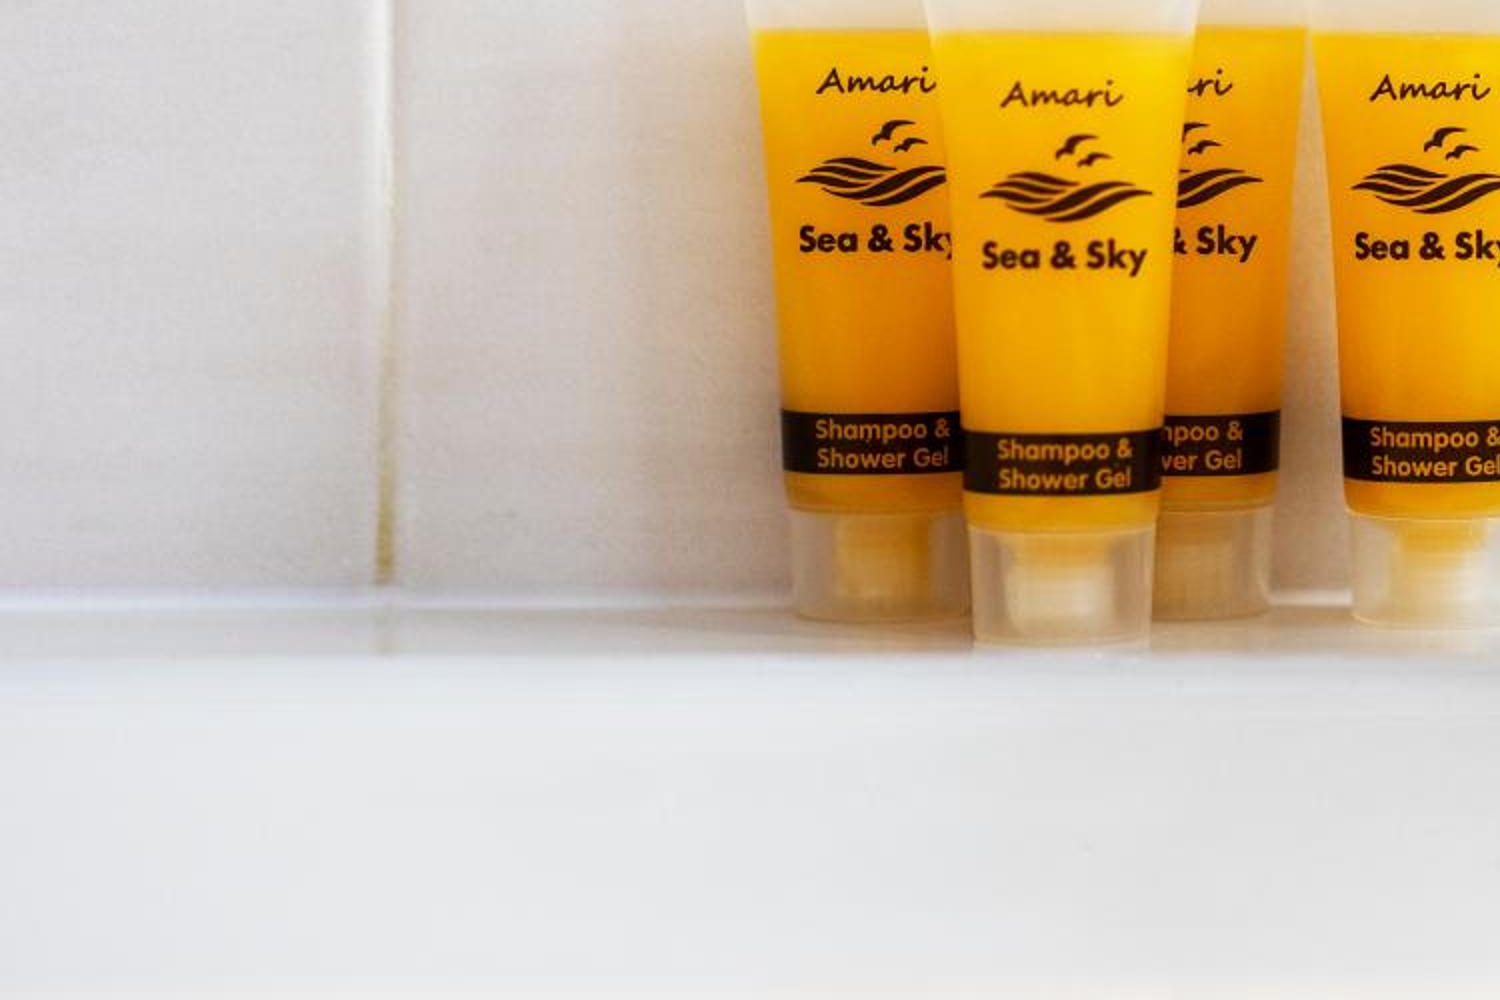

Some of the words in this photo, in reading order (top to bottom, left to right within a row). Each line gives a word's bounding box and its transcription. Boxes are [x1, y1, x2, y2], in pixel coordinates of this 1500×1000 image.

[816, 67, 937, 95] Amari
[1000, 80, 1123, 109] Amari
[1369, 74, 1491, 102] Amari
[799, 225, 858, 252] Sea
[867, 224, 894, 252] &
[1196, 224, 1258, 264] Sky
[1355, 232, 1410, 261] Sea
[1419, 232, 1446, 261] &
[982, 241, 1041, 270] Sea
[1050, 241, 1077, 270] &
[1087, 239, 1148, 278] Sky
[815, 418, 927, 445] Shampoo
[934, 417, 951, 438] &
[1226, 420, 1244, 441] &
[1370, 426, 1480, 453] Shampoo
[817, 447, 906, 469] Shower
[913, 446, 949, 468] Gel
[997, 438, 1110, 467] Shampoo
[1117, 437, 1133, 459] &
[1205, 447, 1243, 470] Gel
[1371, 455, 1458, 477] Shower
[1000, 468, 1088, 490] Shower
[1095, 466, 1132, 489] Gel
